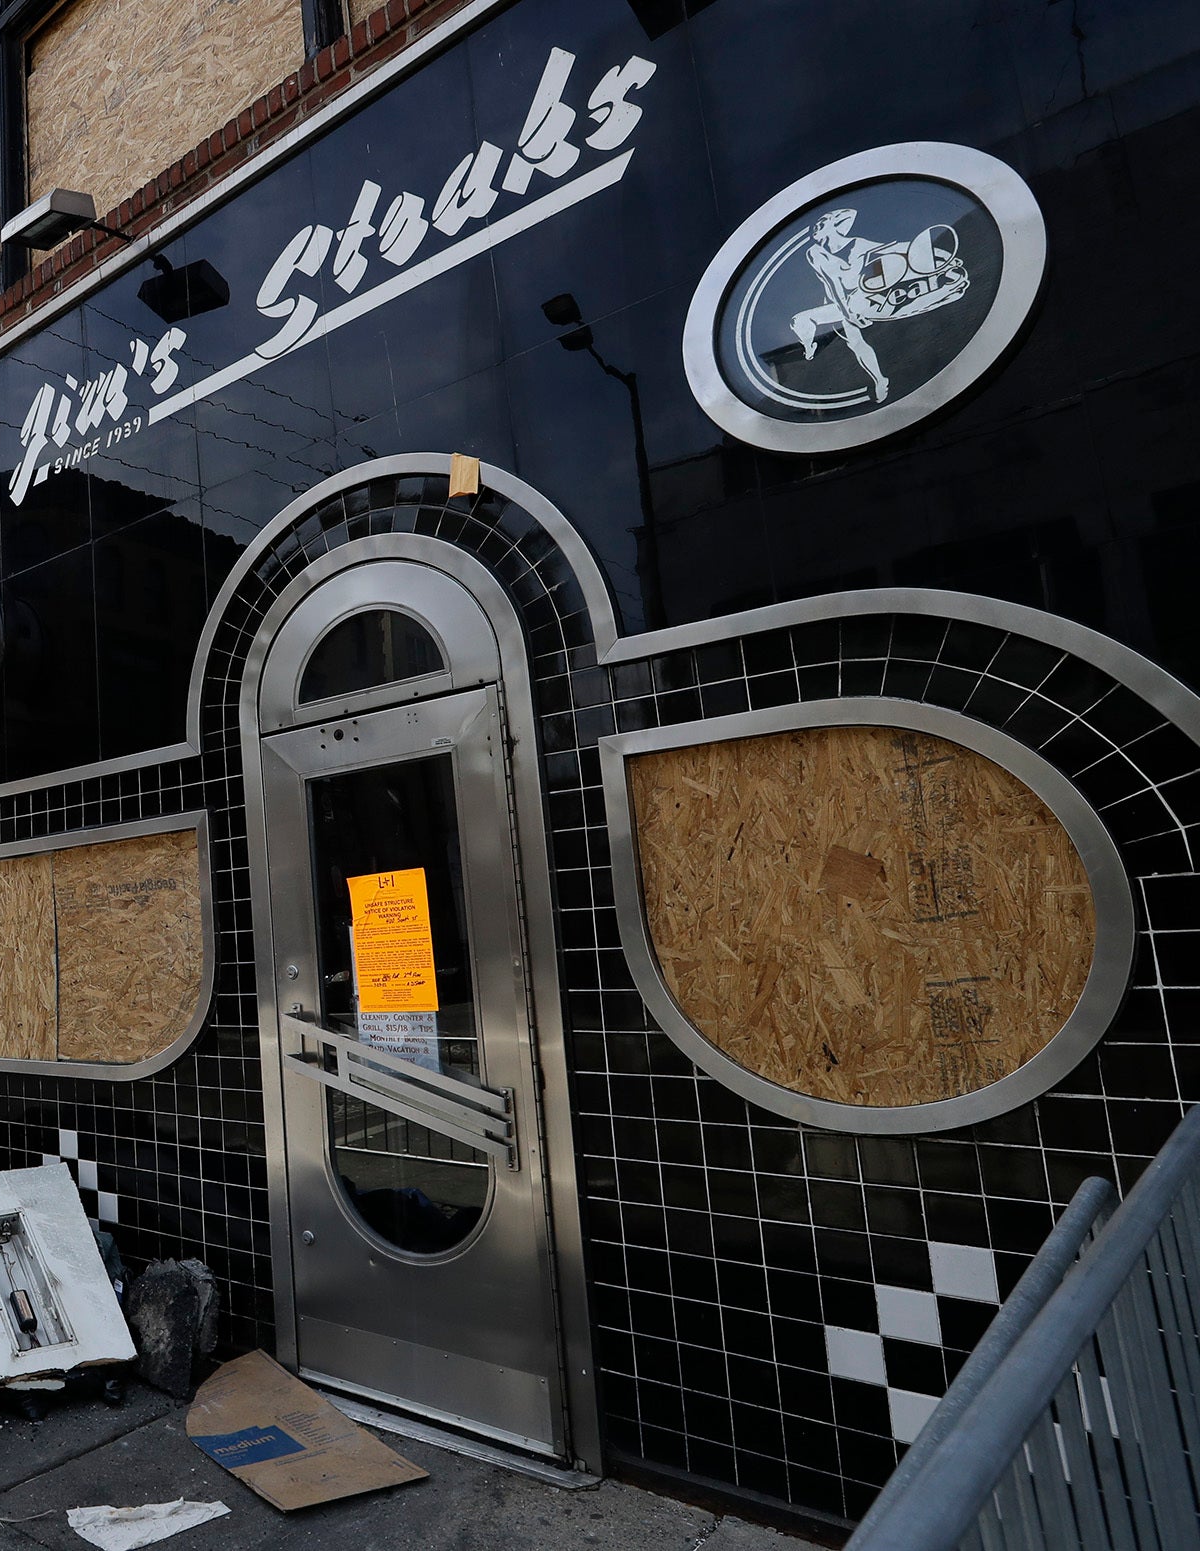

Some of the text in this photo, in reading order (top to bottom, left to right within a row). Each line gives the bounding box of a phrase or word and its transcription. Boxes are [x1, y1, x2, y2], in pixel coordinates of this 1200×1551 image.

[859, 224, 959, 293] 50
[9, 46, 657, 507] Jim's Steaks
[54, 416, 142, 474] SINCE 1939
[364, 898, 414, 909] UNSAFE STRUCTURE
[360, 1013, 434, 1022] CLEANUP, COUNTER &
[362, 1023, 383, 1032] GRILL,
[385, 1024, 409, 1033] $15/18
[418, 1024, 434, 1032] TIPS
[387, 1045, 420, 1053] VACATION
[213, 1434, 276, 1455] medium
